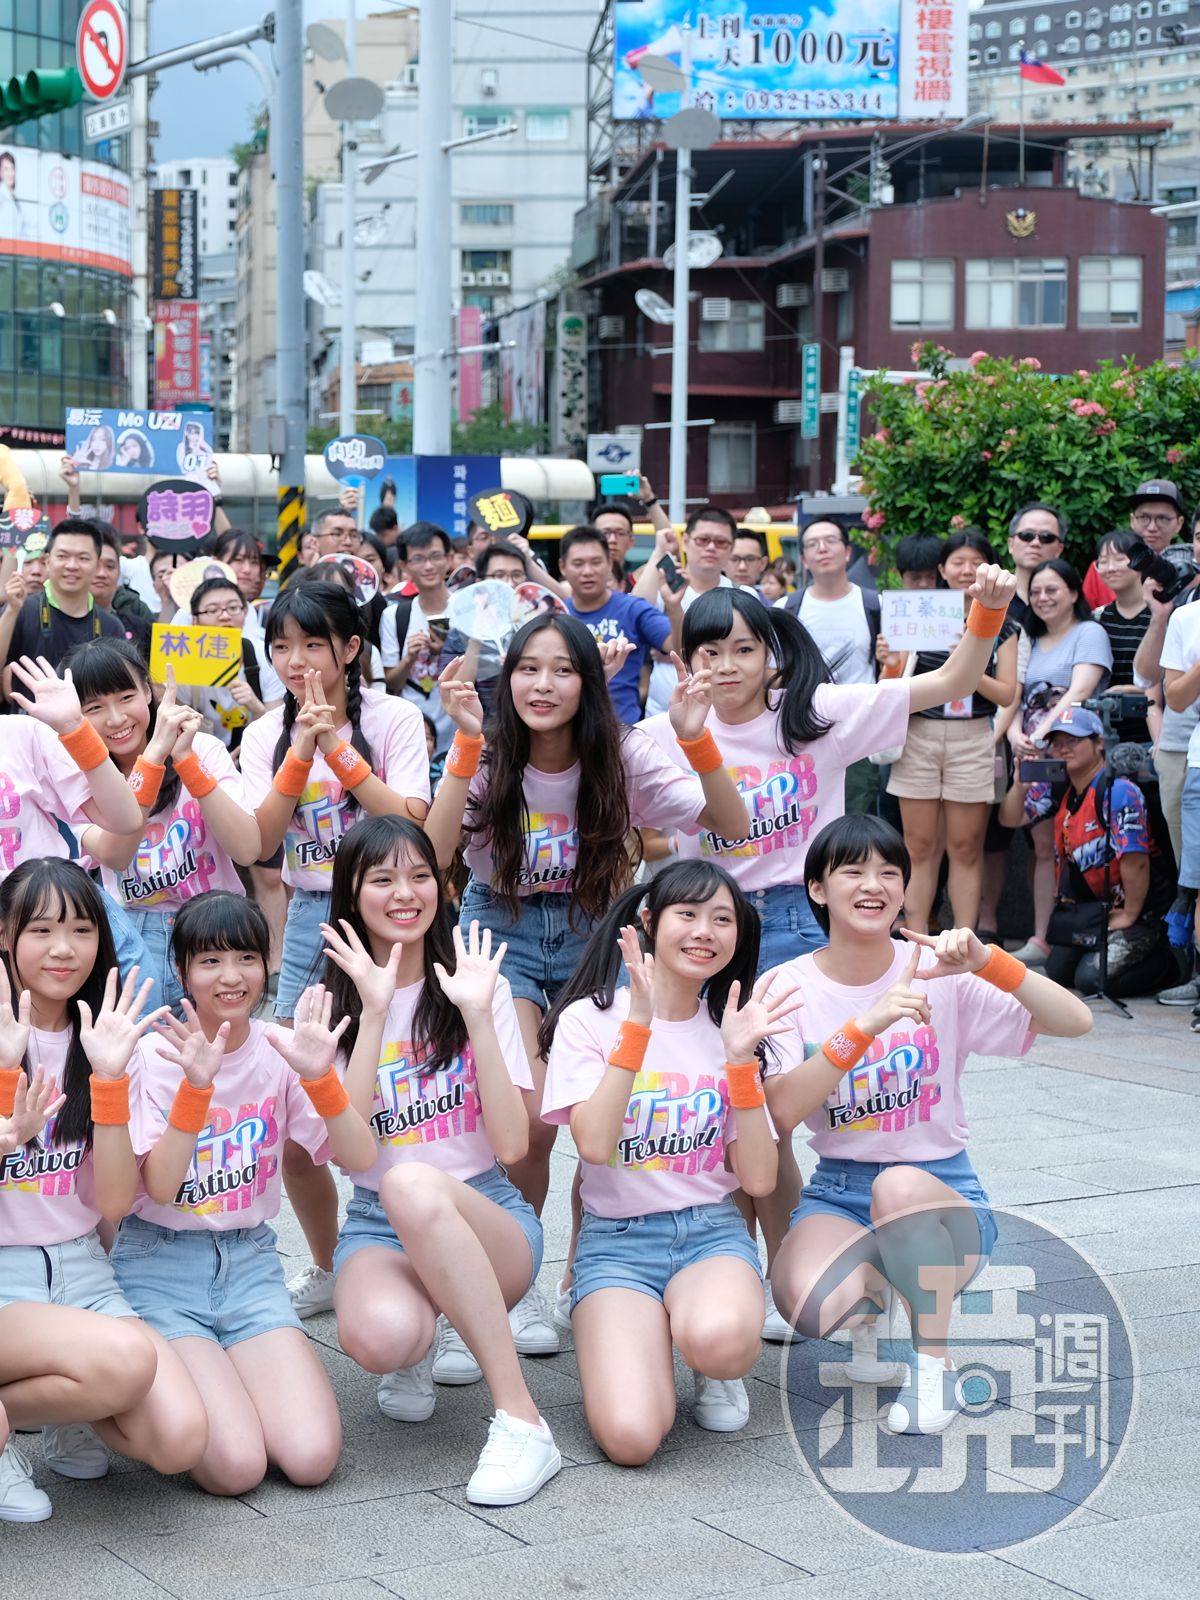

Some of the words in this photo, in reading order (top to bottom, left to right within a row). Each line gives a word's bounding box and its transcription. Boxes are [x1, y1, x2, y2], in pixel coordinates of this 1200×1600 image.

[750, 27, 896, 69] 1000元
[745, 92, 883, 111] 0932158344
[117, 412, 144, 428] Mo
[295, 834, 344, 867] Festi
[120, 848, 197, 902] Festival
[368, 1081, 465, 1140] Festival
[625, 1086, 725, 1146] TTP
[827, 1077, 922, 1131] Festival
[617, 1125, 722, 1167] Festival
[173, 1158, 259, 1208] Festiva
